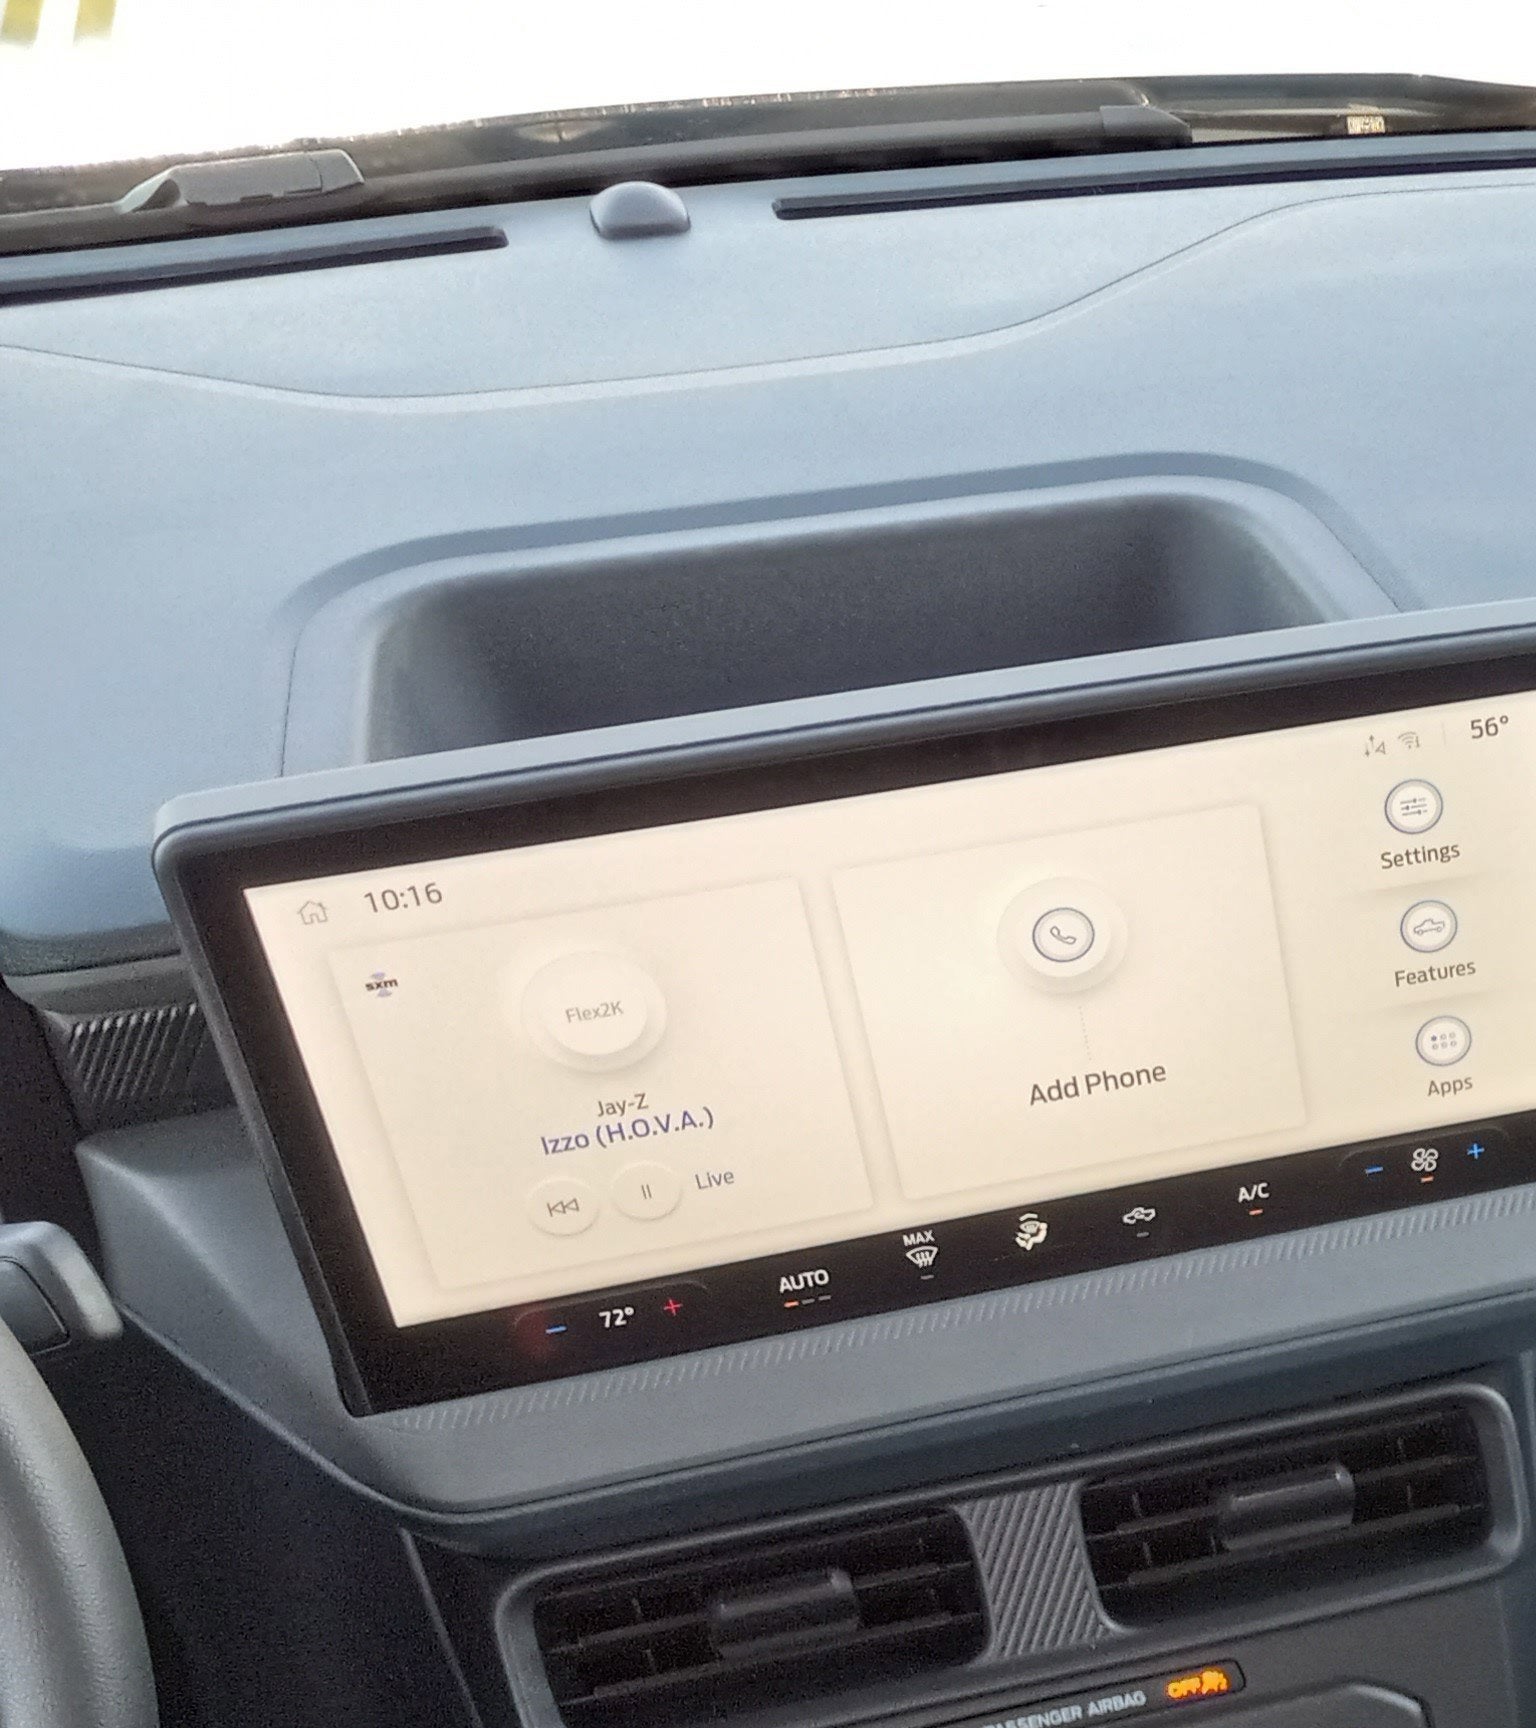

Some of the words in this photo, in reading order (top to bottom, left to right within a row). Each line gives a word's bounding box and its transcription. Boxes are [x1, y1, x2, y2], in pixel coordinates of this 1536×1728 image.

[1469, 714, 1510, 741] 56°
[1380, 841, 1461, 872] Settings
[362, 881, 443, 915] 10:16
[1394, 958, 1477, 987] Features
[564, 1000, 625, 1025] Flex2K
[1028, 1075, 1080, 1106] Add
[1085, 1062, 1168, 1096] Phone
[1426, 1074, 1474, 1098] Apps
[597, 1092, 649, 1118] Jay-Z
[539, 1127, 590, 1156] Izzo
[595, 1106, 715, 1149] (H.O.V.A.)
[694, 1167, 735, 1190] Live
[1237, 1181, 1270, 1202] A/C
[903, 1230, 935, 1248] MAX
[778, 1268, 830, 1294] AUTO
[598, 1305, 635, 1328] 72°
[1087, 1690, 1148, 1719] AIRBAG
